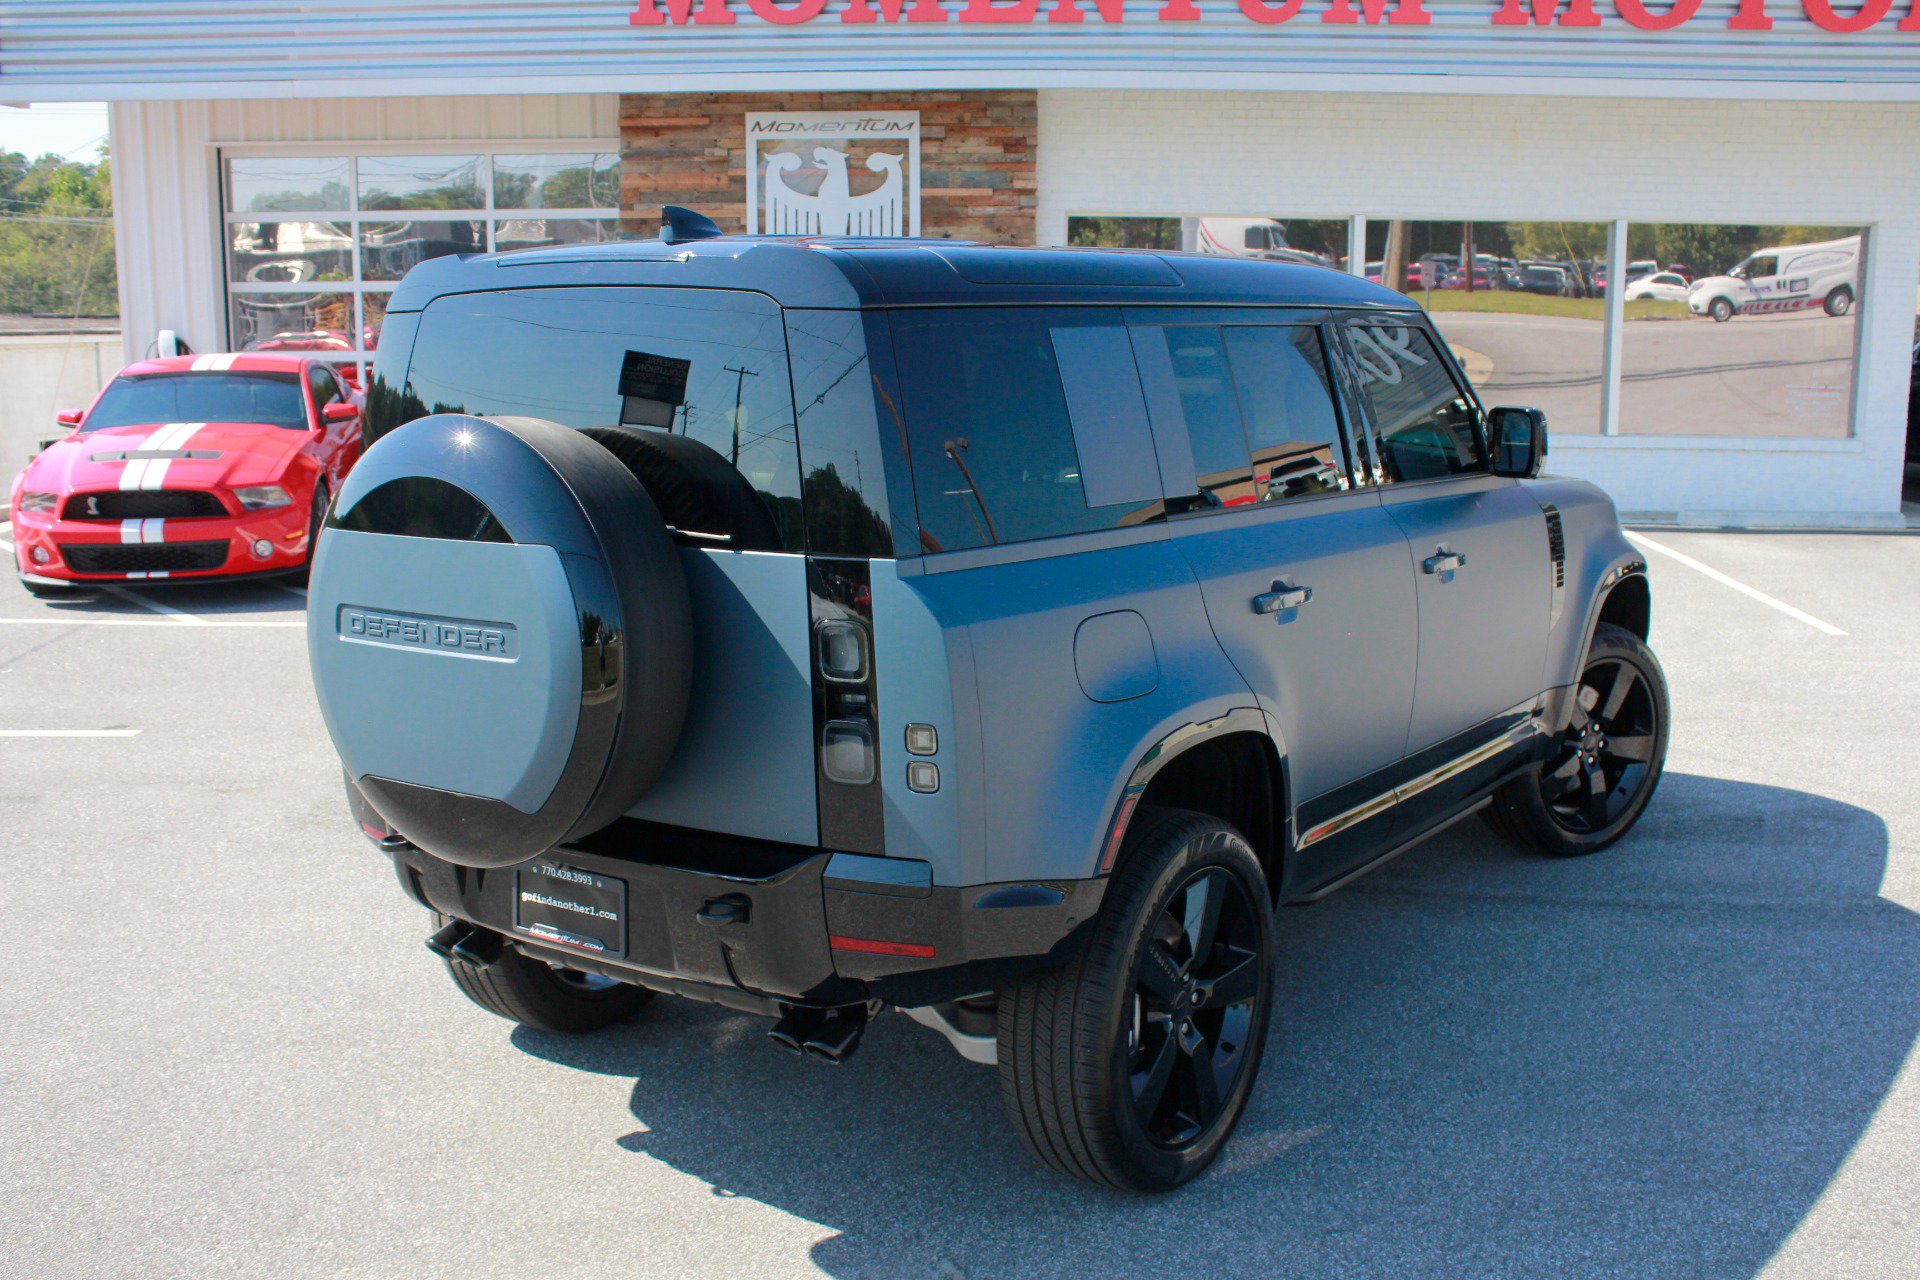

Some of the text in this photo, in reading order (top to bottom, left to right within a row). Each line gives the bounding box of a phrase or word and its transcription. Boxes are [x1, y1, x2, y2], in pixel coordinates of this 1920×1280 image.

[350, 612, 506, 653] DEFENDER
[541, 865, 592, 885] 770.428.3993
[521, 891, 618, 921] gofindanother1.com
